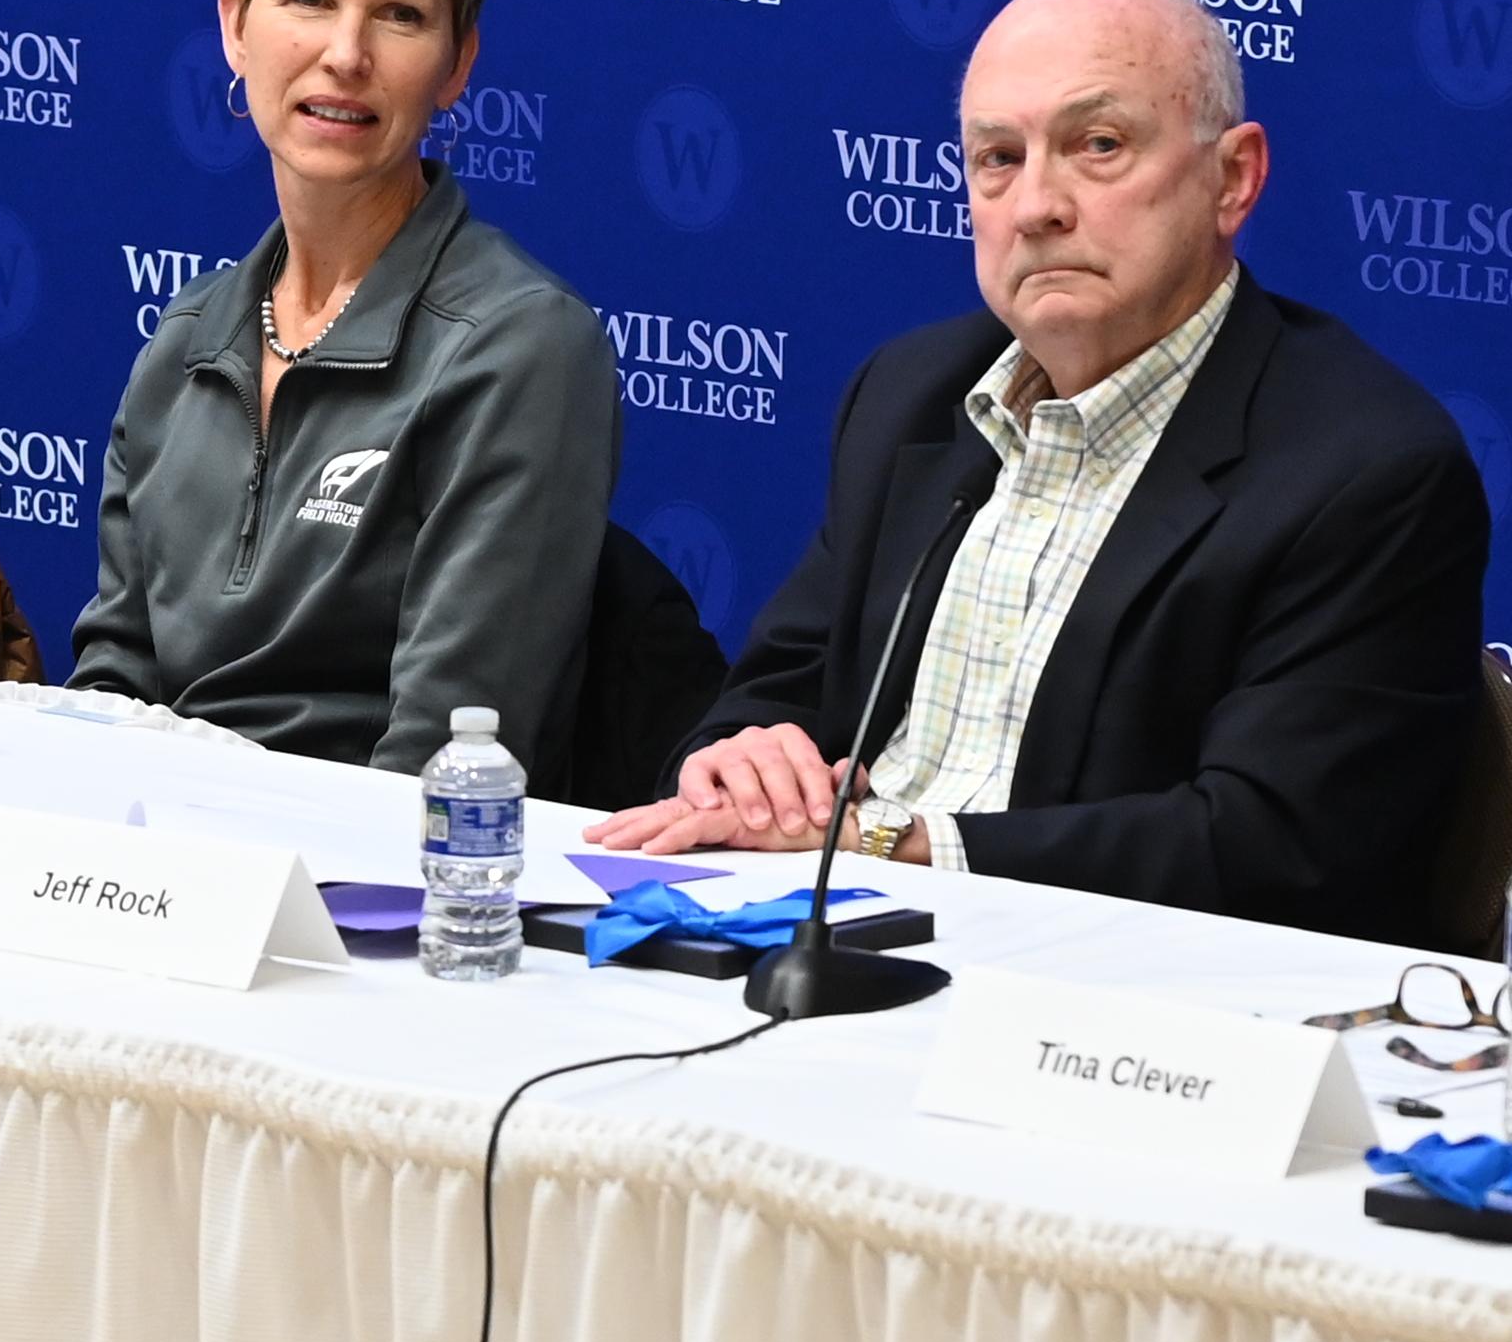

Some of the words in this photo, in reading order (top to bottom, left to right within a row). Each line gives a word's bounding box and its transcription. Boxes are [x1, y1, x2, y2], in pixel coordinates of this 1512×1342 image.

[296, 507, 325, 522] FIELD
[33, 872, 94, 905] Jeff
[96, 881, 173, 919] Rock
[1038, 1040, 1100, 1080] Tina
[1111, 1056, 1213, 1100] Clever
